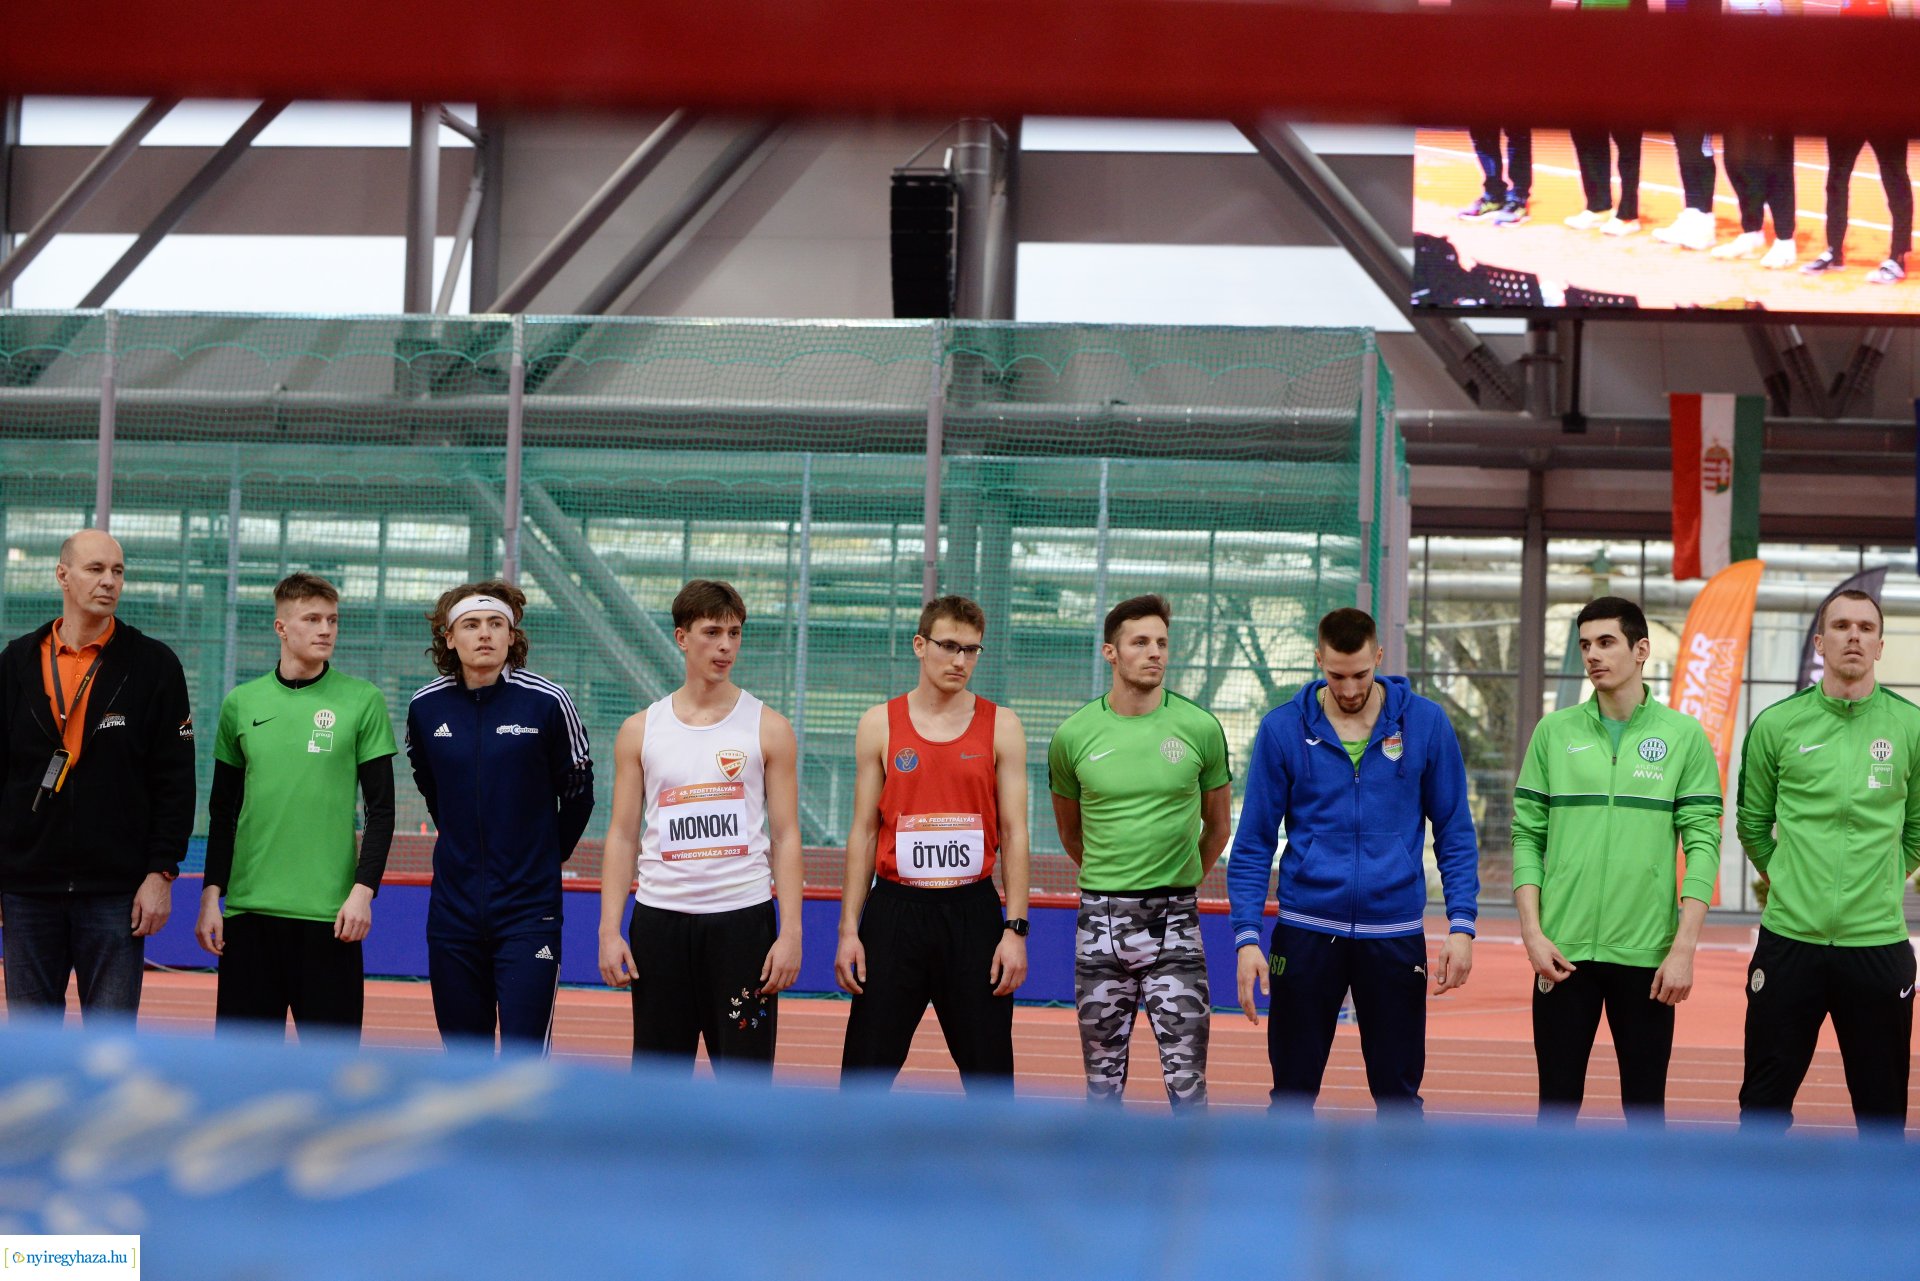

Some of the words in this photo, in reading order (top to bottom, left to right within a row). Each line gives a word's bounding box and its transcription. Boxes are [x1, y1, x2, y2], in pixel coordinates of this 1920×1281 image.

[1680, 632, 1713, 720] GYAR
[1633, 769, 1664, 781] MVM
[669, 813, 739, 842] MONOKI
[671, 849, 723, 860] NYÍREGYHÁZA
[723, 848, 741, 856] 2023
[912, 840, 971, 869] ÖTVÖS
